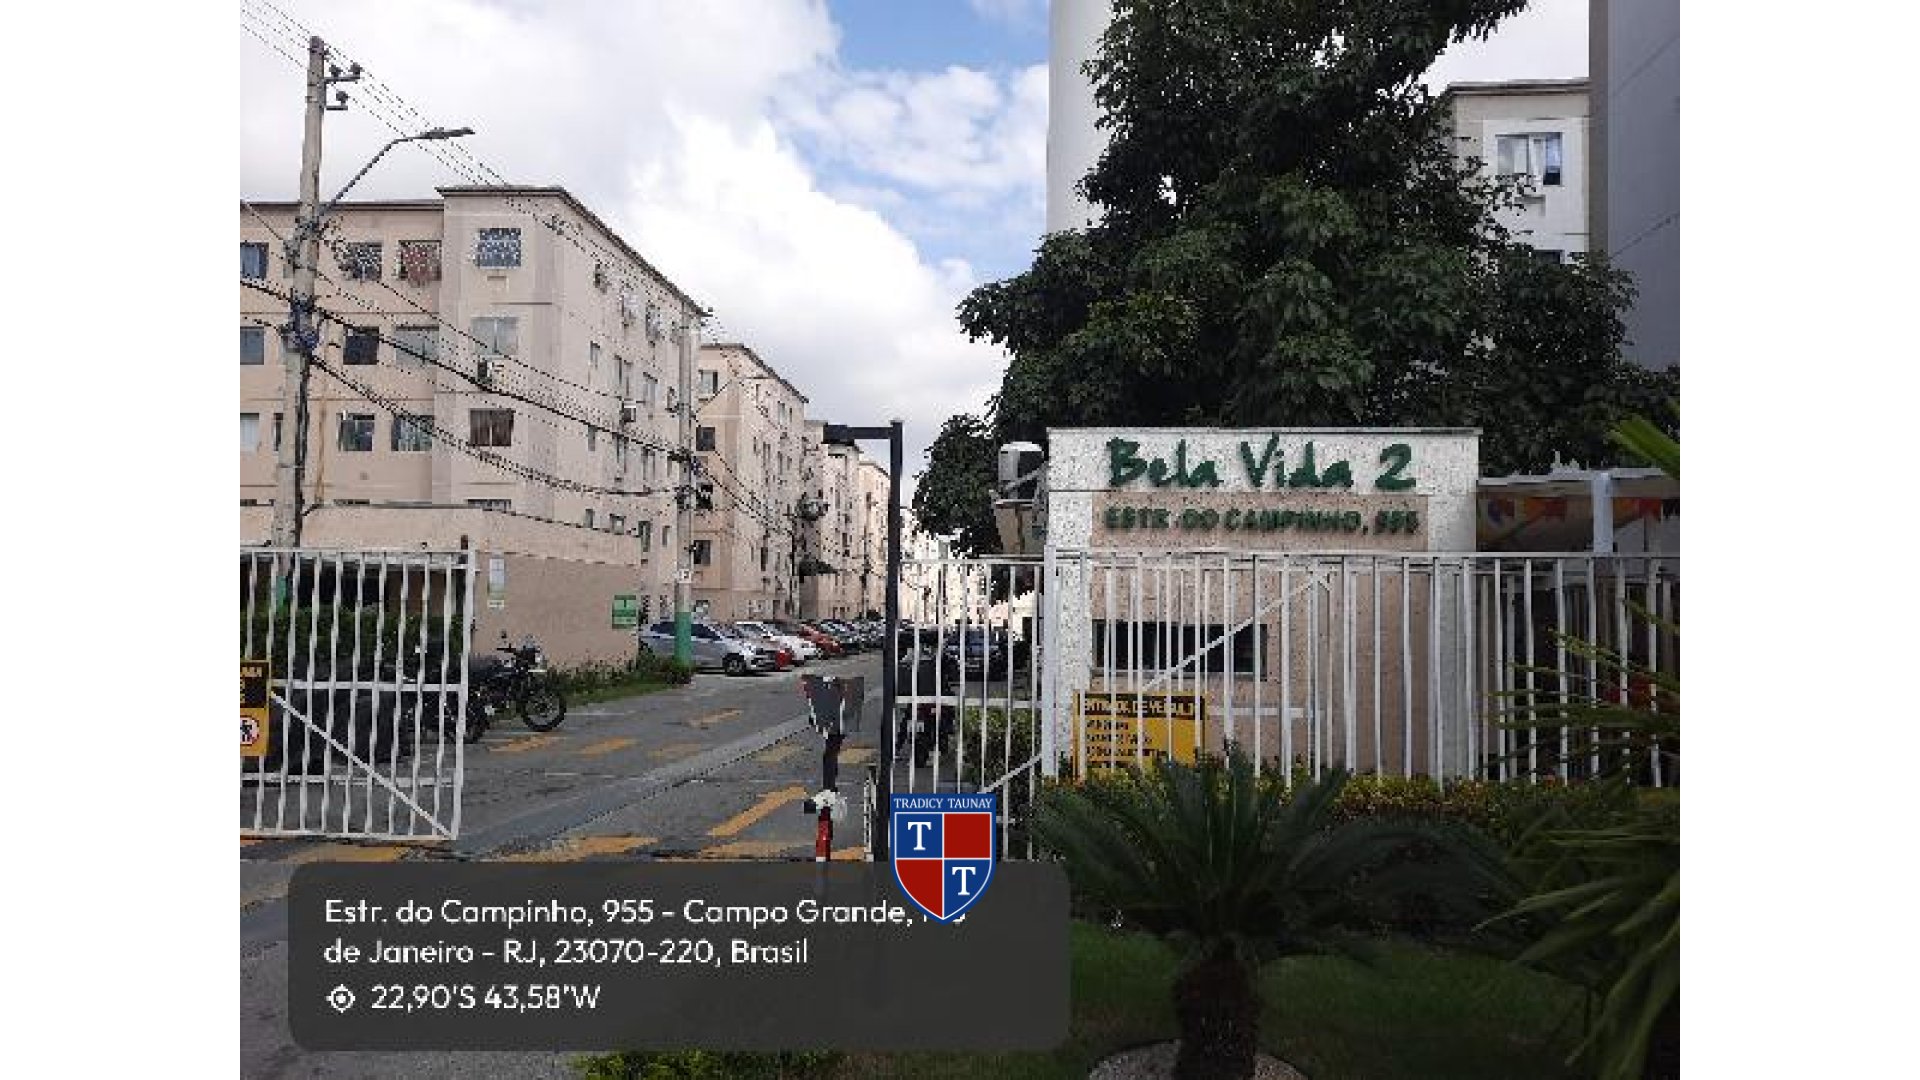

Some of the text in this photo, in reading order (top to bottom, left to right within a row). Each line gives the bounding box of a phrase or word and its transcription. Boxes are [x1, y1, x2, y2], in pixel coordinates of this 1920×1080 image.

[1106, 432, 1417, 490] Bela Vida 2
